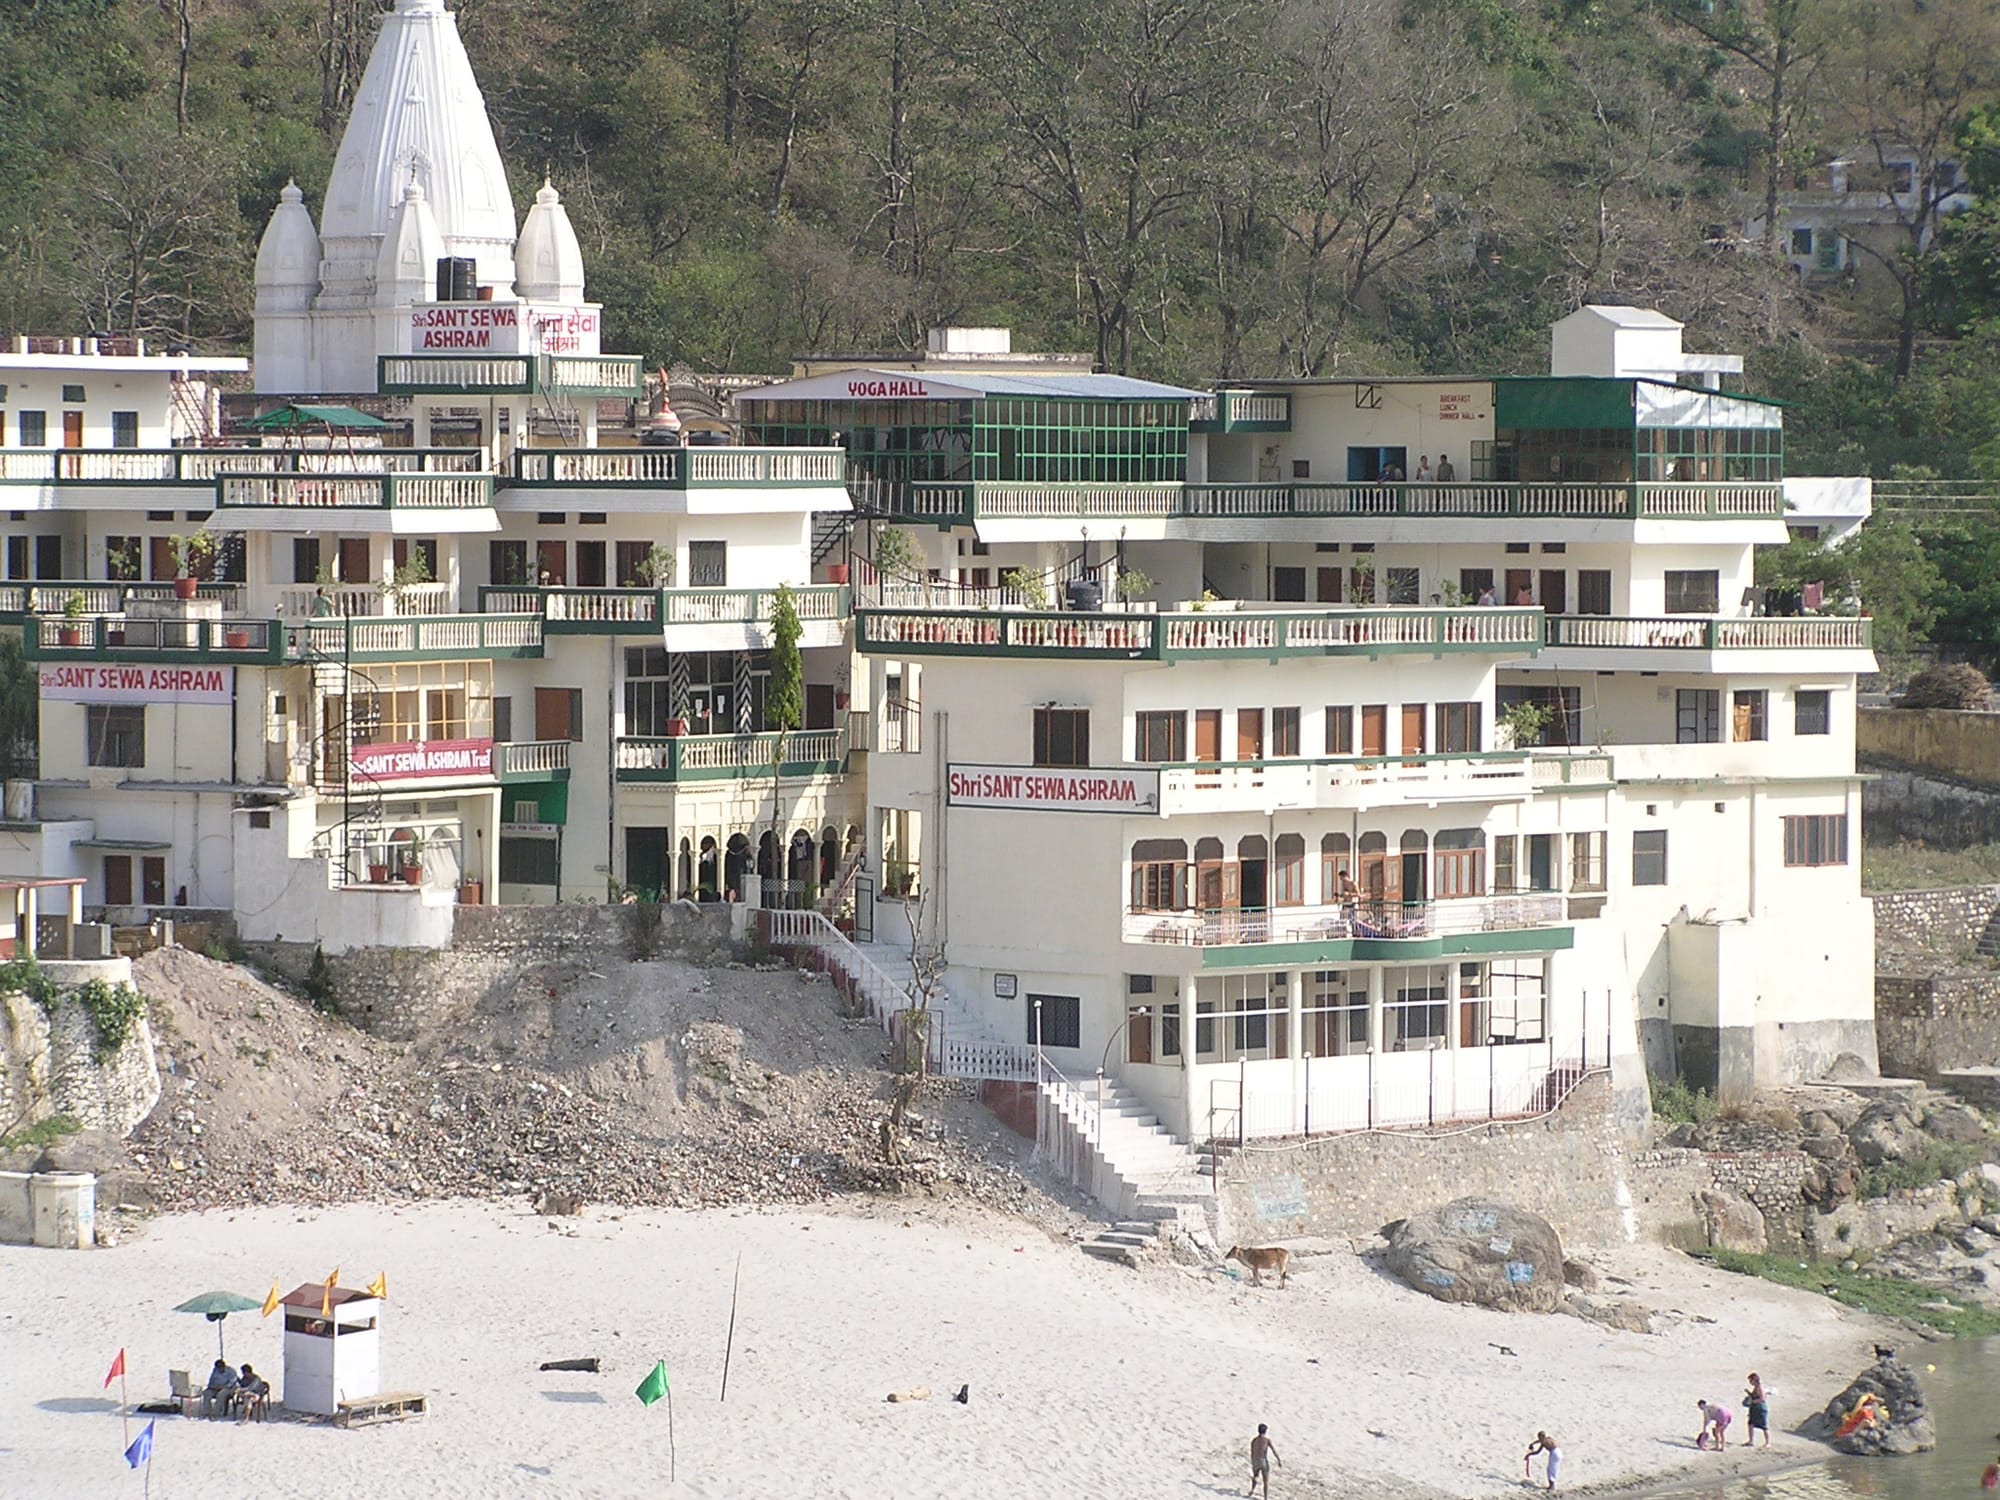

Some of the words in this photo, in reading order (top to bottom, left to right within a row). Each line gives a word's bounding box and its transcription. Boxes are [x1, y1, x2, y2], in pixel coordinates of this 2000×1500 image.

[427, 309, 468, 327] SANT
[471, 308, 517, 326] SEWA
[567, 307, 597, 334] सेवा
[424, 330, 490, 348] ASHRAM
[848, 382, 887, 396] YOGA
[889, 381, 927, 396] HALL
[40, 672, 57, 687] Shri
[56, 668, 96, 688] SANT
[99, 668, 145, 689] SEWA
[149, 670, 224, 691] ASHRAM
[365, 754, 395, 773] SANT
[395, 751, 427, 772] SEWA
[427, 748, 471, 769] ASHRAM
[951, 773, 982, 797] Shri
[983, 776, 1023, 798] SANT
[1025, 777, 1067, 800] SEWA
[1068, 780, 1137, 801] ASHRAM
